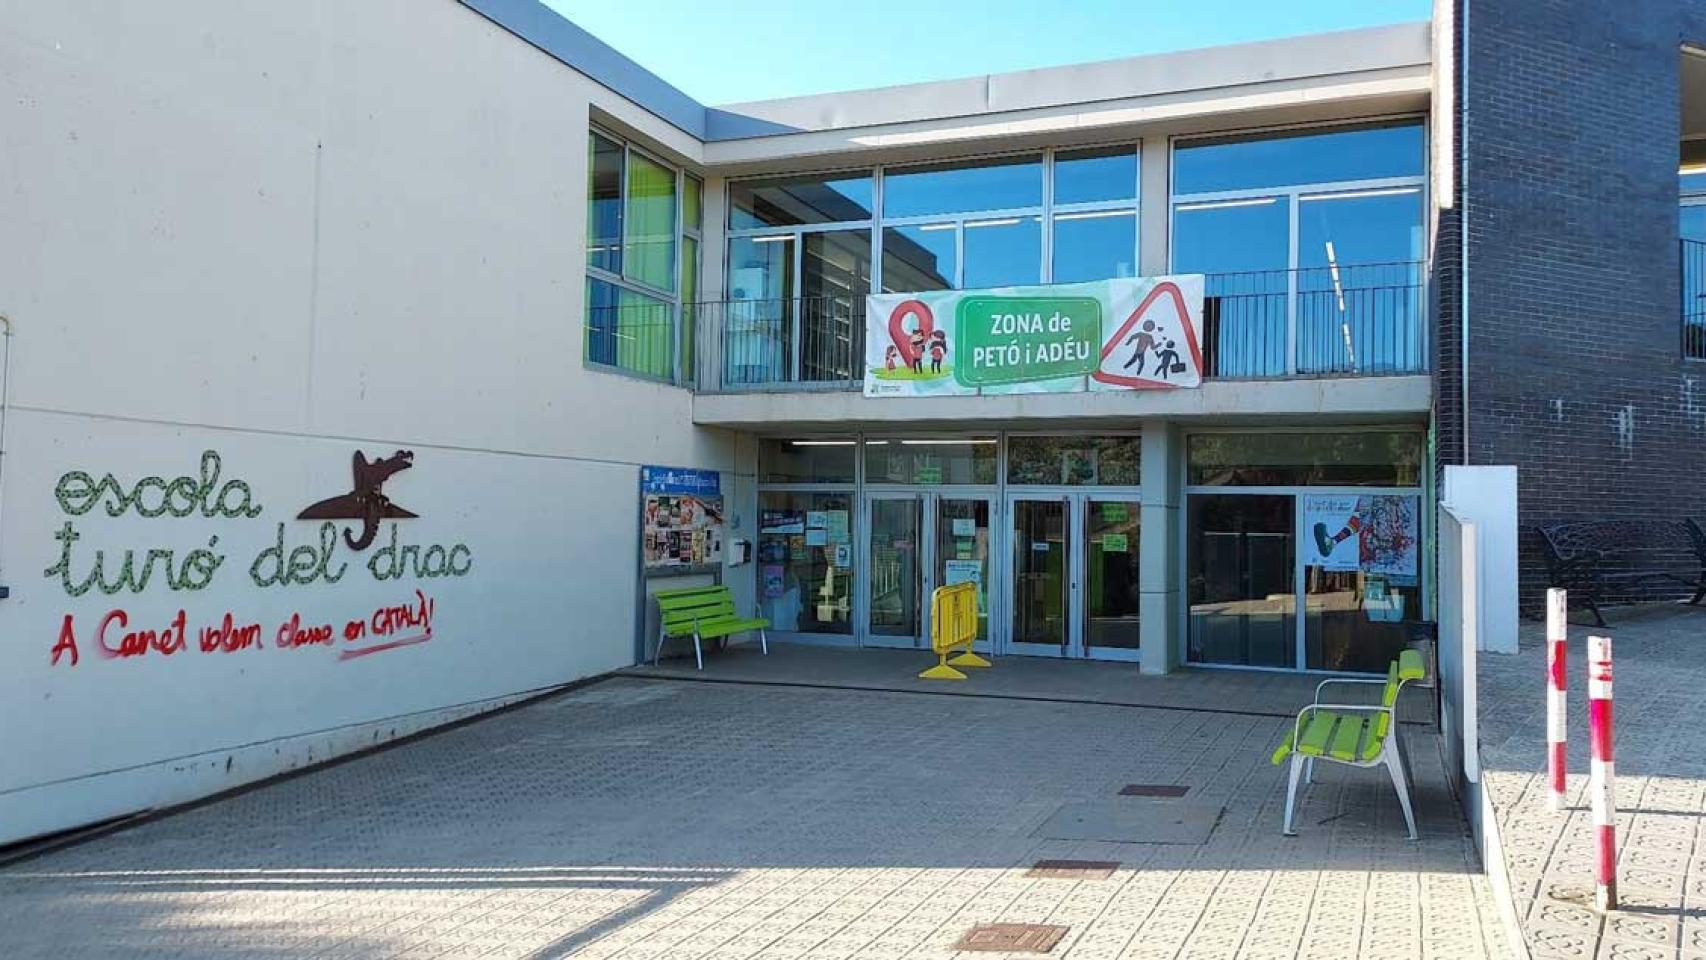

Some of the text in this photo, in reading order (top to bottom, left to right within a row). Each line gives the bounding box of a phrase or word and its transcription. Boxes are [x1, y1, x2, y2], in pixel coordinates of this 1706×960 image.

[973, 335, 1090, 368] PETÓ i ADÉU
[990, 312, 1071, 334] ZONA de
[54, 449, 263, 518] escola
[43, 521, 473, 597] turó del drac
[51, 588, 434, 667] A Canet volem classe en CATALÀ!
